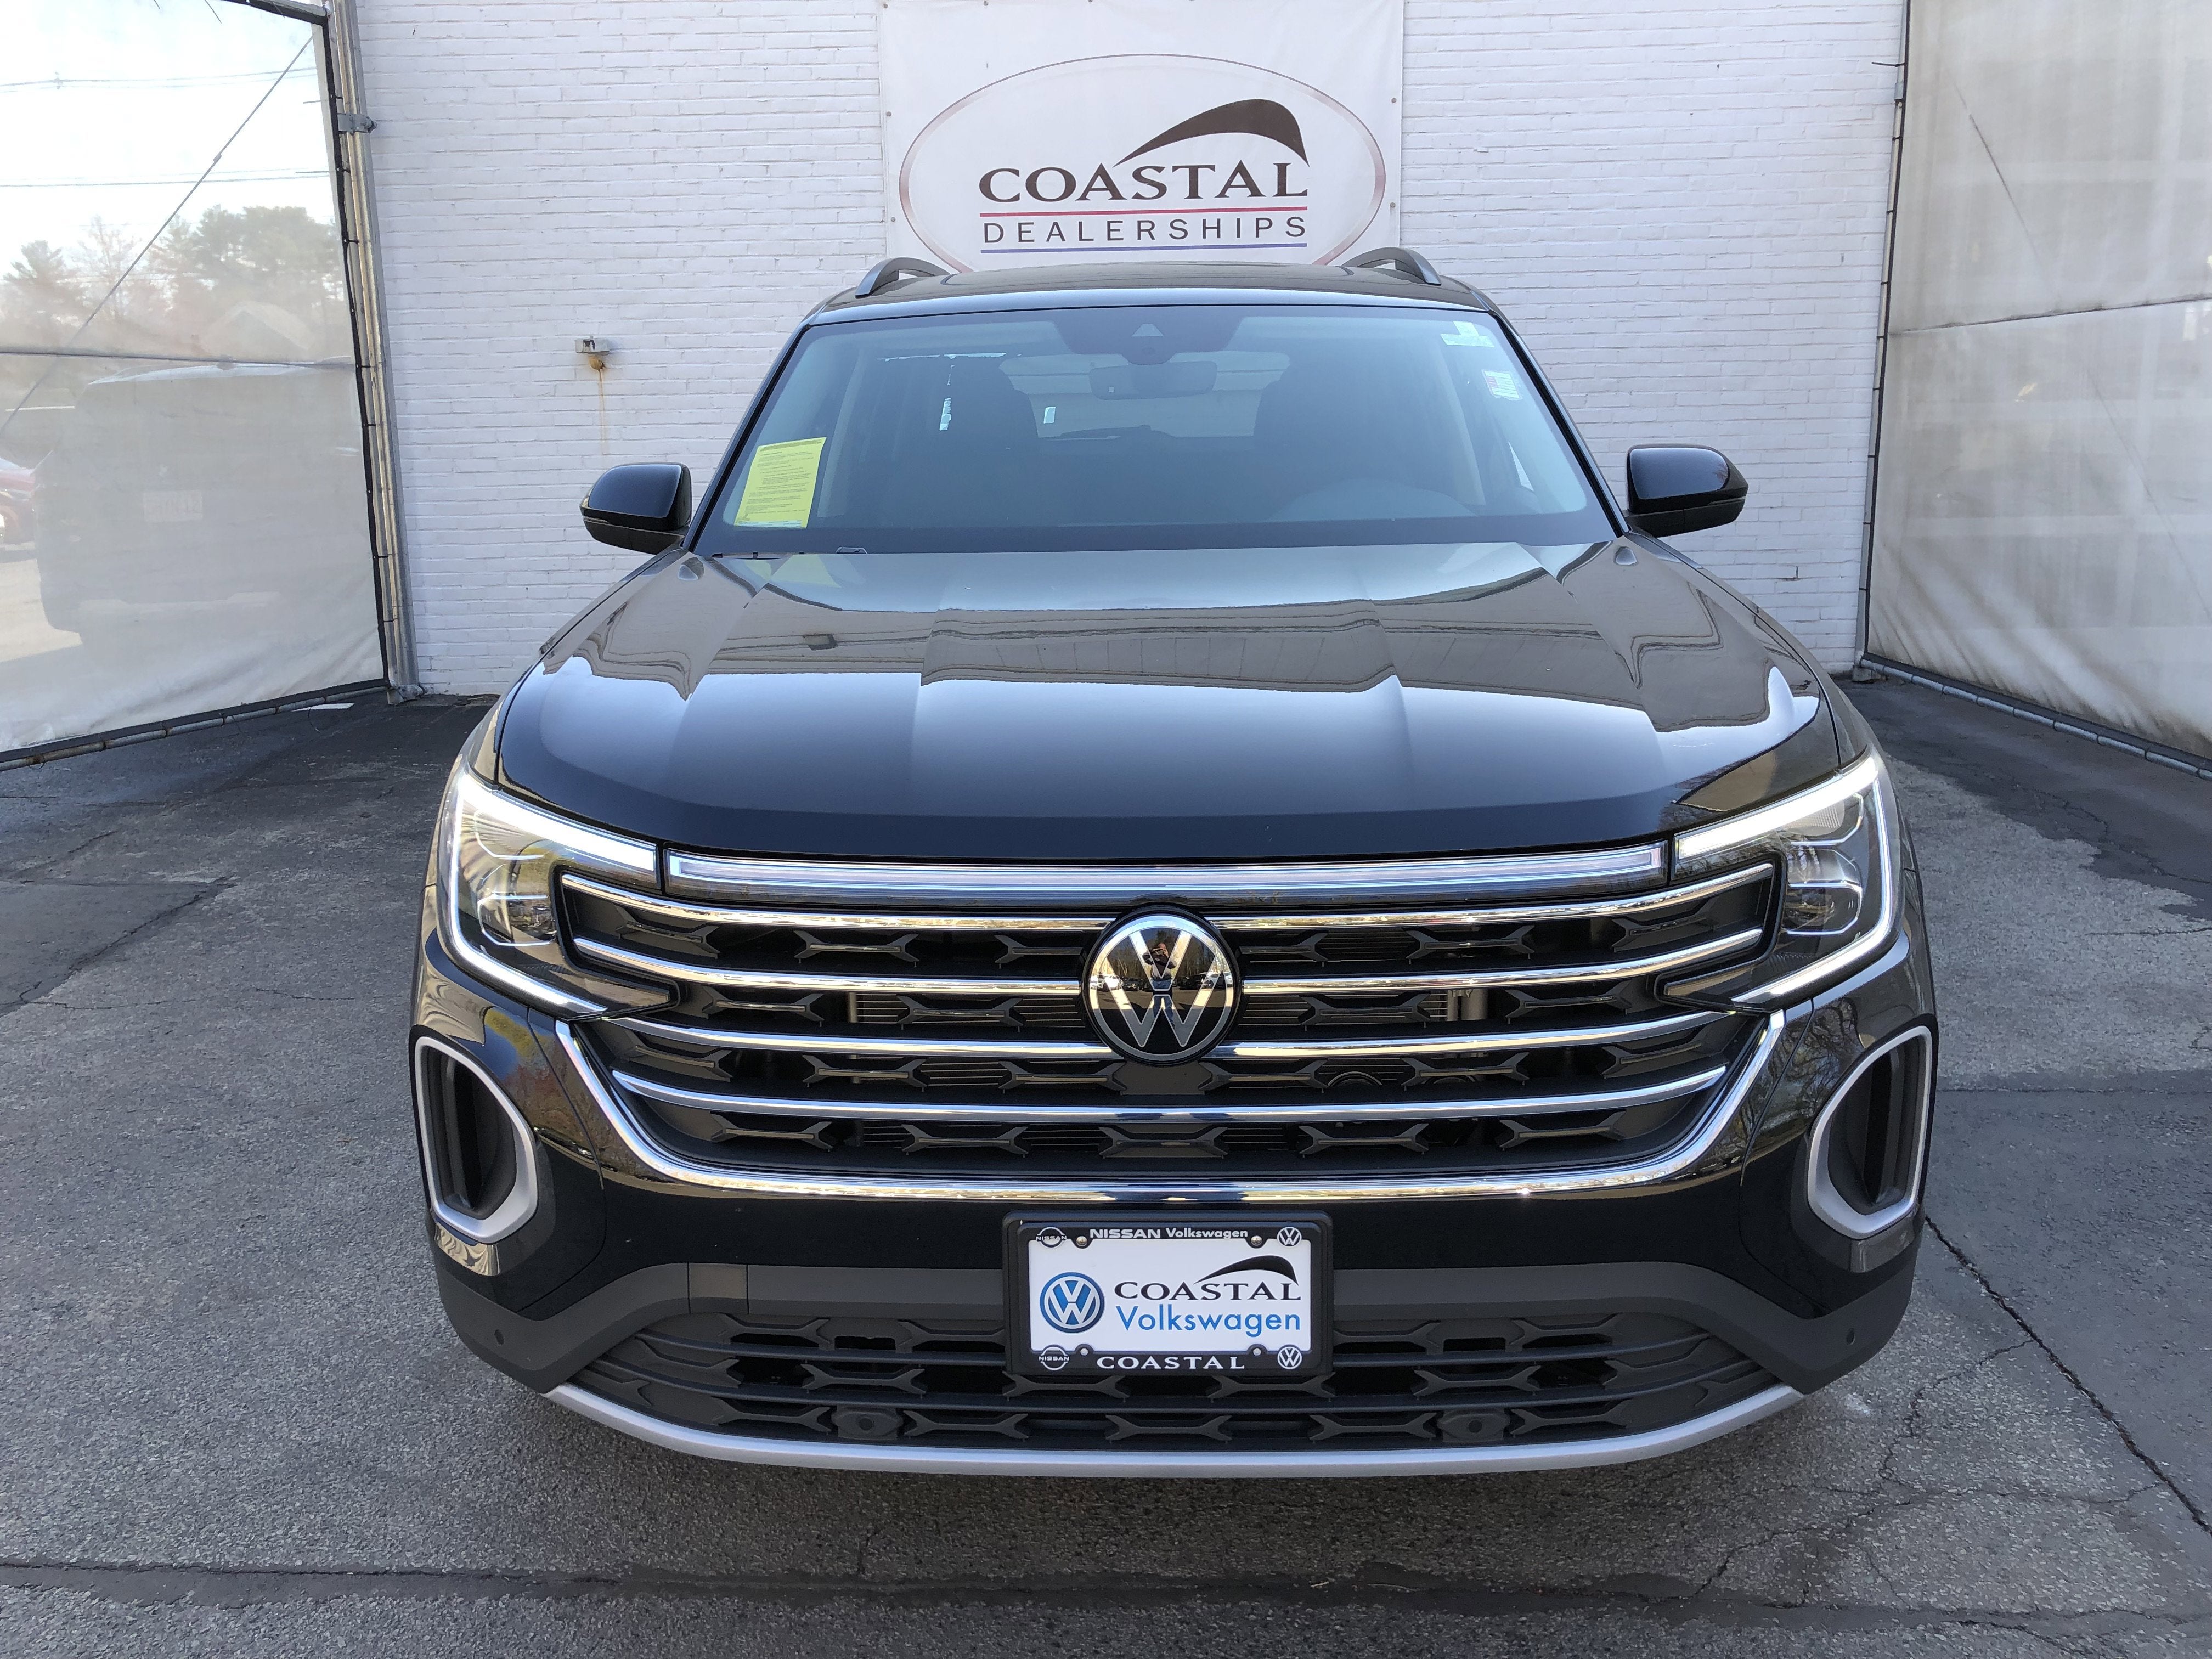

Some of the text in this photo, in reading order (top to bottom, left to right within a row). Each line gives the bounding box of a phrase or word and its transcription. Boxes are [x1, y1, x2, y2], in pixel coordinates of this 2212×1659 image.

[979, 160, 1308, 202] COASTAL
[984, 216, 1306, 244] DEALERSHIPS
[1090, 1227, 1248, 1239] NISSAN Volkswagen
[1114, 1282, 1301, 1300] COASTAL
[1116, 1304, 1300, 1337] Volkswagen
[1097, 1356, 1245, 1369] COASTAL
